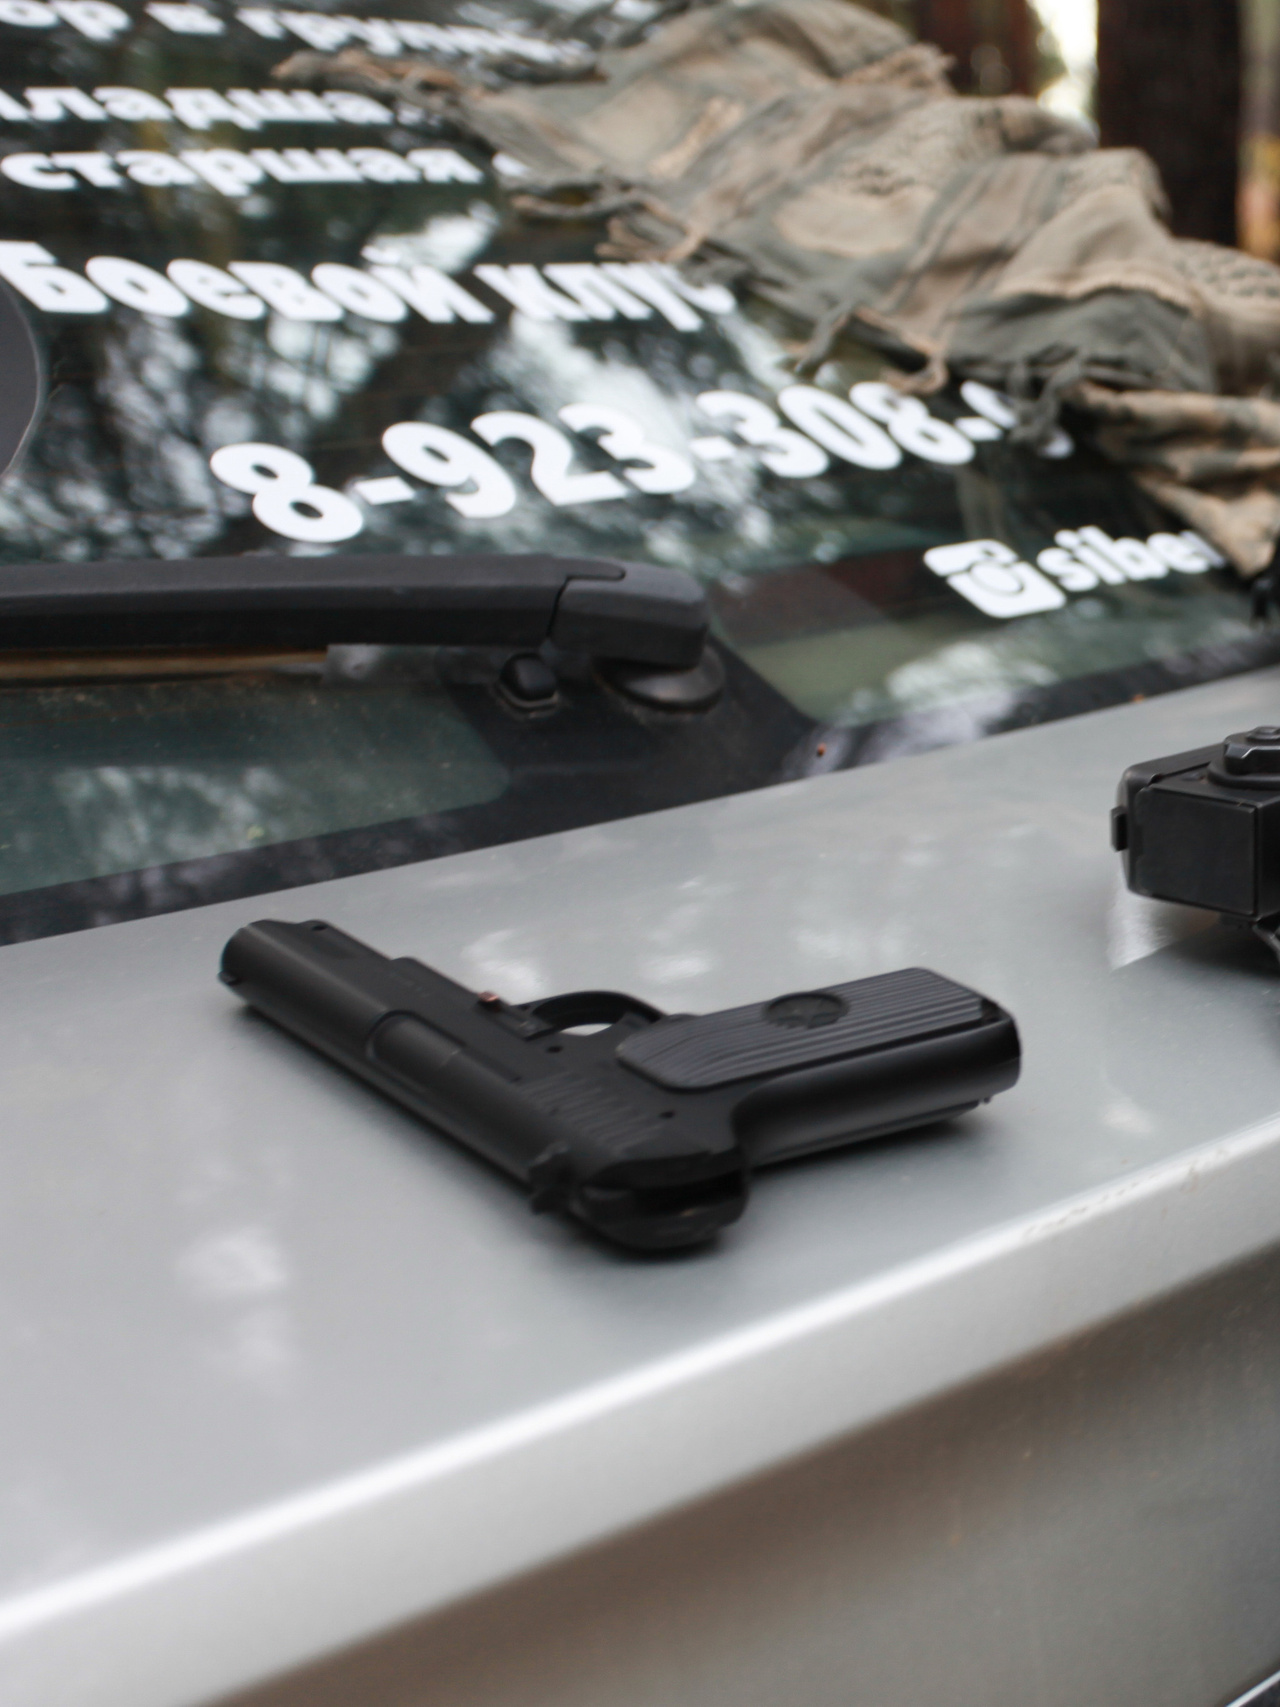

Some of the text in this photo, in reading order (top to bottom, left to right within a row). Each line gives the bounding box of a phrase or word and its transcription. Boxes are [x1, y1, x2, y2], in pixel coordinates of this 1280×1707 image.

[0, 86, 442, 131] ладша
[0, 147, 484, 197] старшая
[0, 240, 495, 323] Боевой
